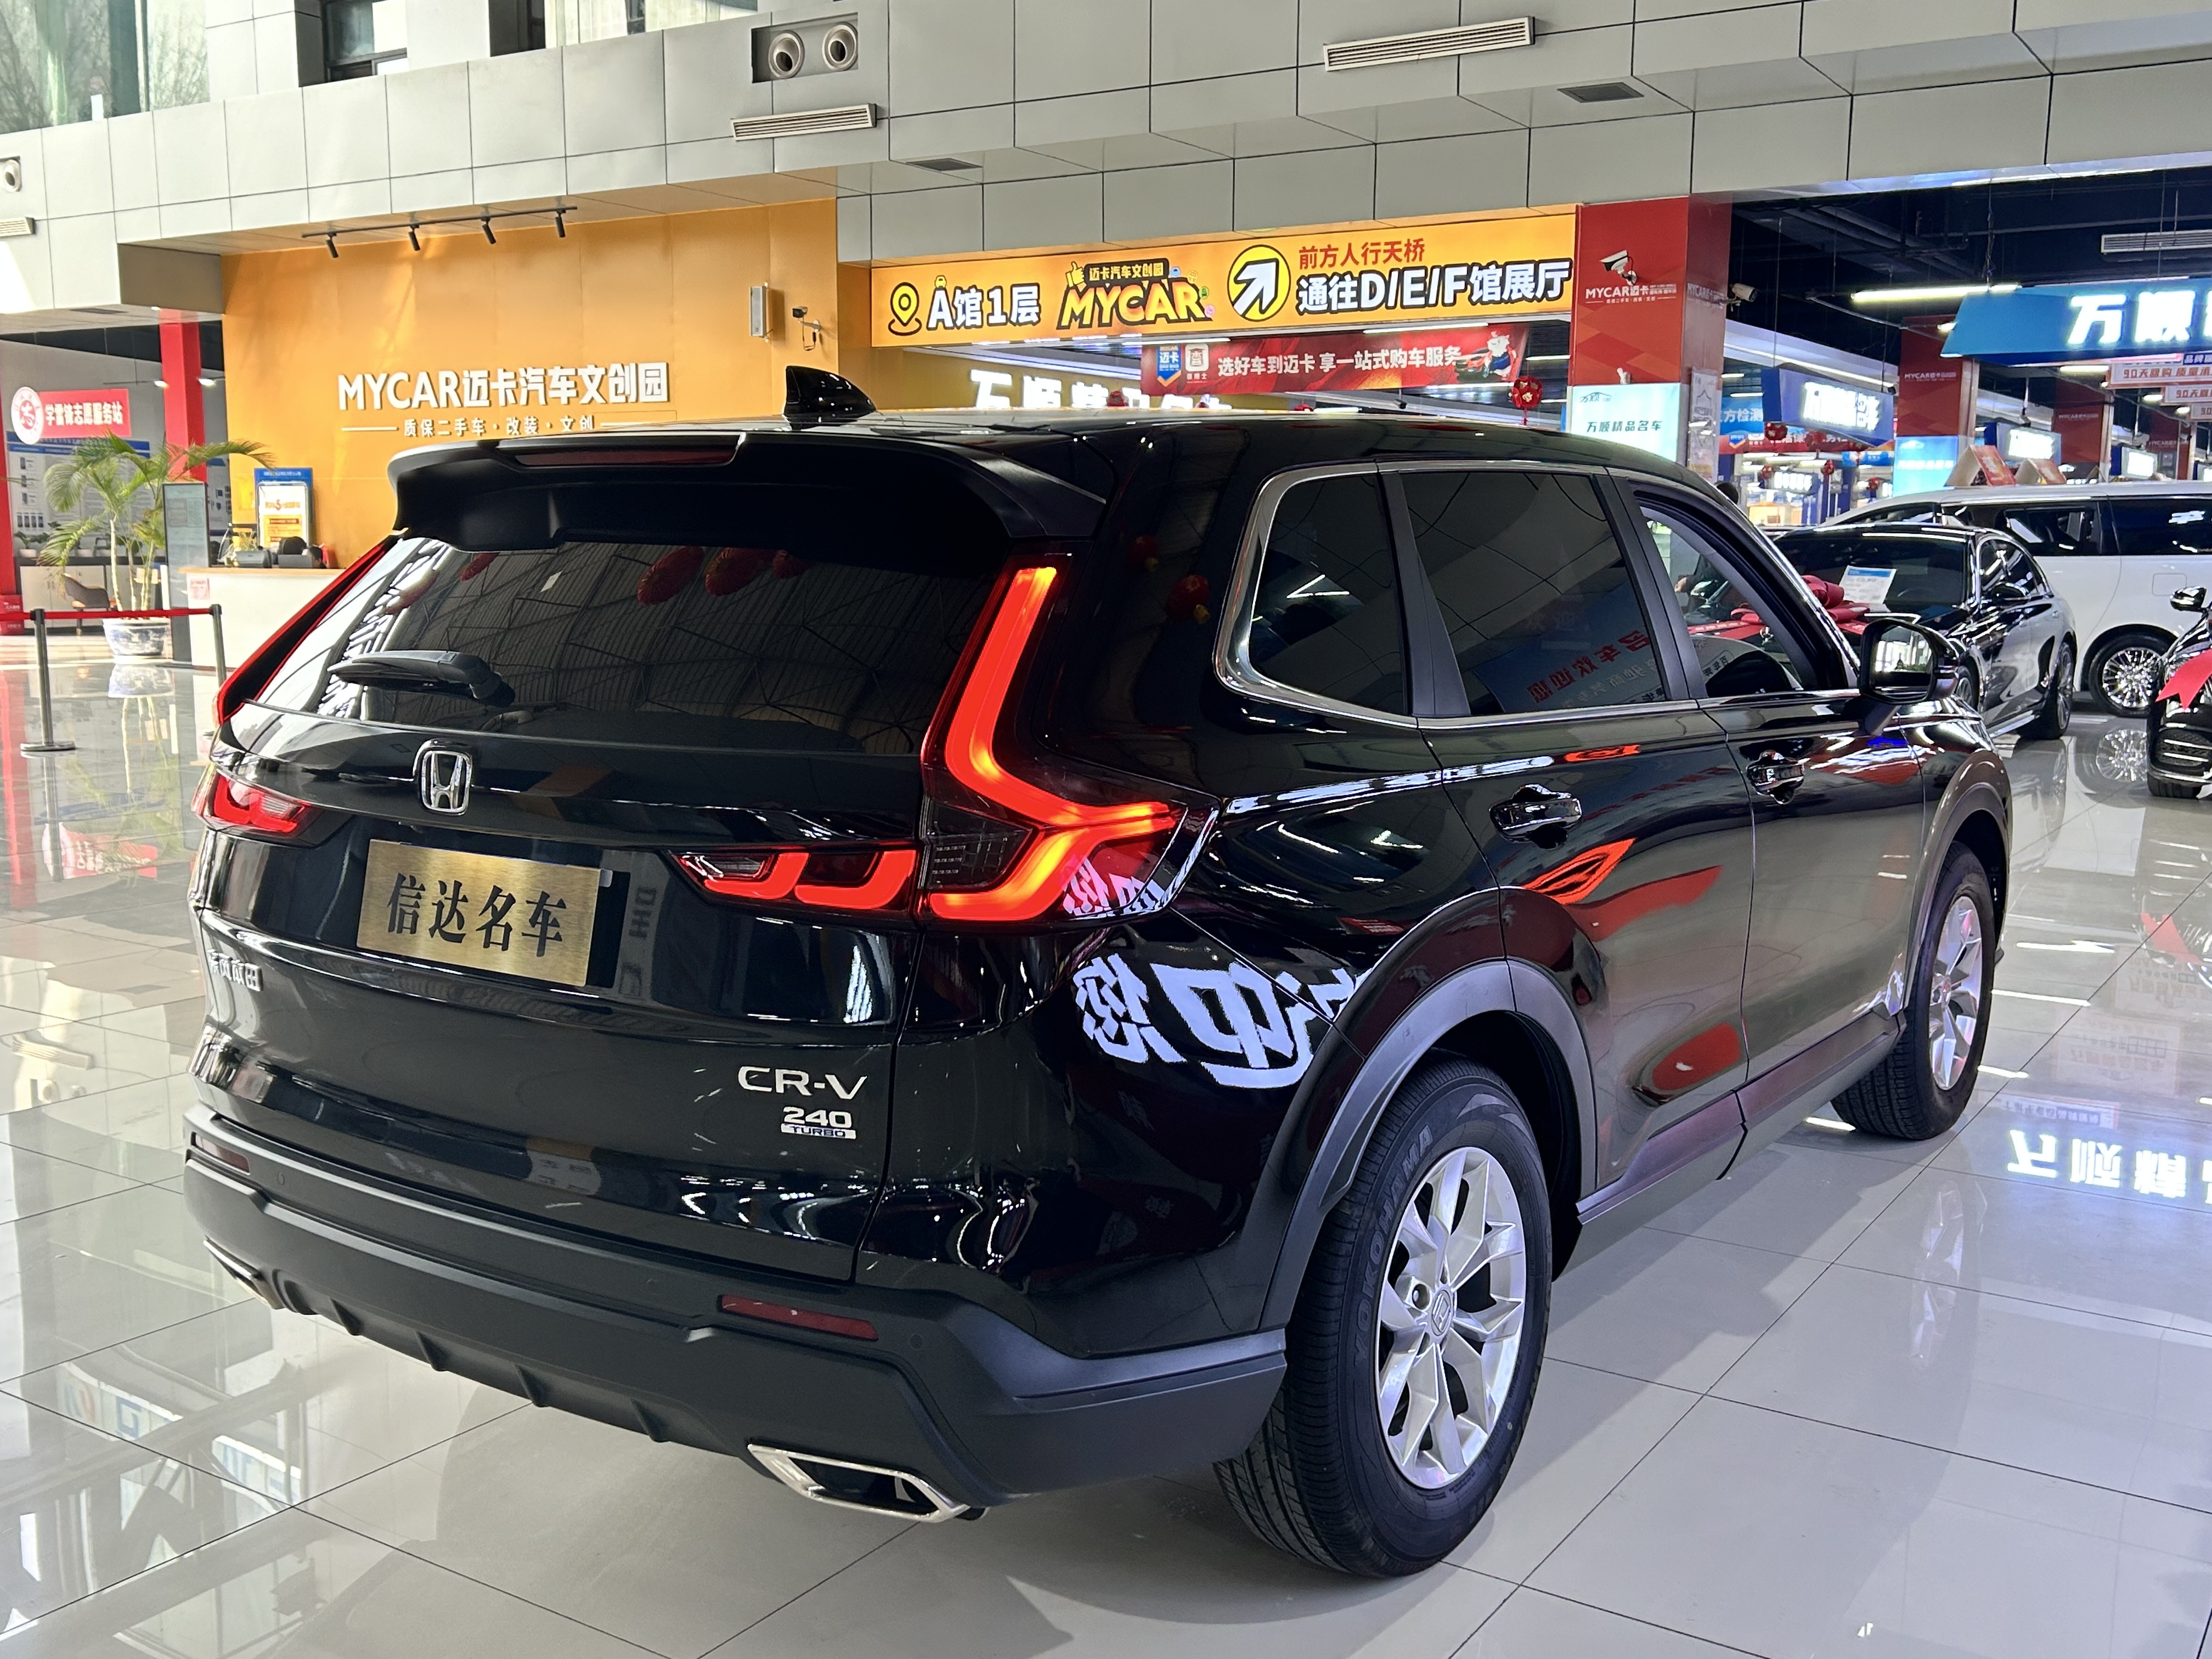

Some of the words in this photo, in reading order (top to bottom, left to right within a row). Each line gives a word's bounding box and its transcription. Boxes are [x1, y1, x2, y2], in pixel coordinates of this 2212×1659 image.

[1299, 238, 1425, 269] 前方人行天桥
[1089, 262, 1164, 281] 迈卡汽车文创园
[1299, 260, 1571, 314] 通往D/E/F馆展厅
[928, 286, 1040, 328] A馆1层
[1060, 280, 1207, 328] MYCAR
[2067, 290, 2212, 345] 万顺
[1159, 351, 1180, 364] 迈卡
[1217, 357, 1316, 377] 选好车到迈卡
[1319, 346, 1462, 373] 享一站式购车服务
[338, 362, 668, 410] MYCAR迈卡汽车文创园
[45, 401, 123, 426] 学雷锋志愿服务站
[1586, 420, 1662, 432] 万顺精品名车
[1719, 408, 1763, 423] 方检测
[387, 872, 567, 957] 信达名车
[738, 1066, 868, 1100] CR-V
[782, 1107, 852, 1128] 240
[791, 1125, 847, 1138] TURBO
[1353, 1126, 1434, 1368] YOKOHAMA
